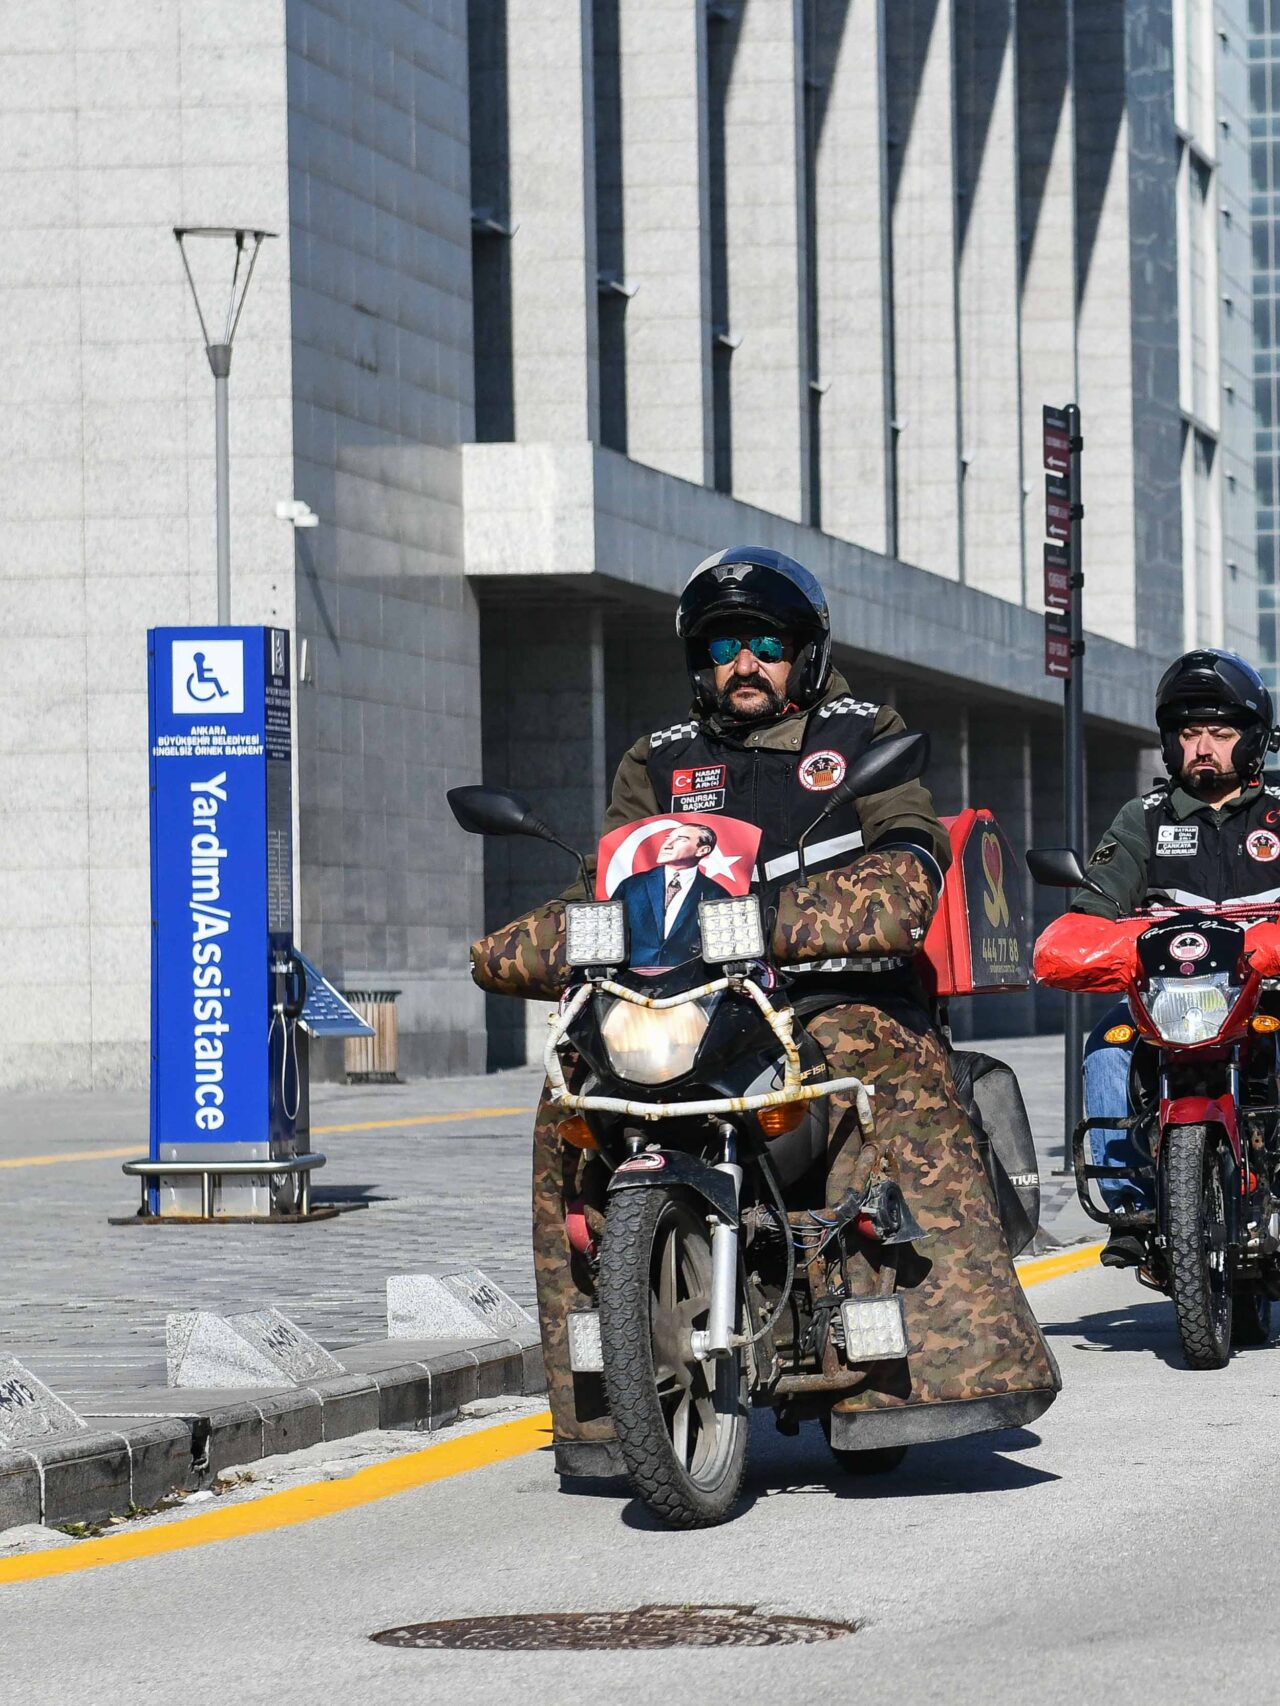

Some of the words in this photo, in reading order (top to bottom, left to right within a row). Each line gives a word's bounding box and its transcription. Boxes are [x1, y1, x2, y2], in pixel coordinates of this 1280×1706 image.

[190, 725, 227, 735] ANKARA
[695, 768, 721, 778] HASAN
[680, 793, 718, 805] ONURSAL
[682, 800, 716, 812] BAŞKAN
[188, 771, 231, 1131] Yardım/Assistance
[982, 937, 998, 962] 444
[997, 937, 1007, 962] 77
[1009, 1174, 1039, 1186] TIVE
